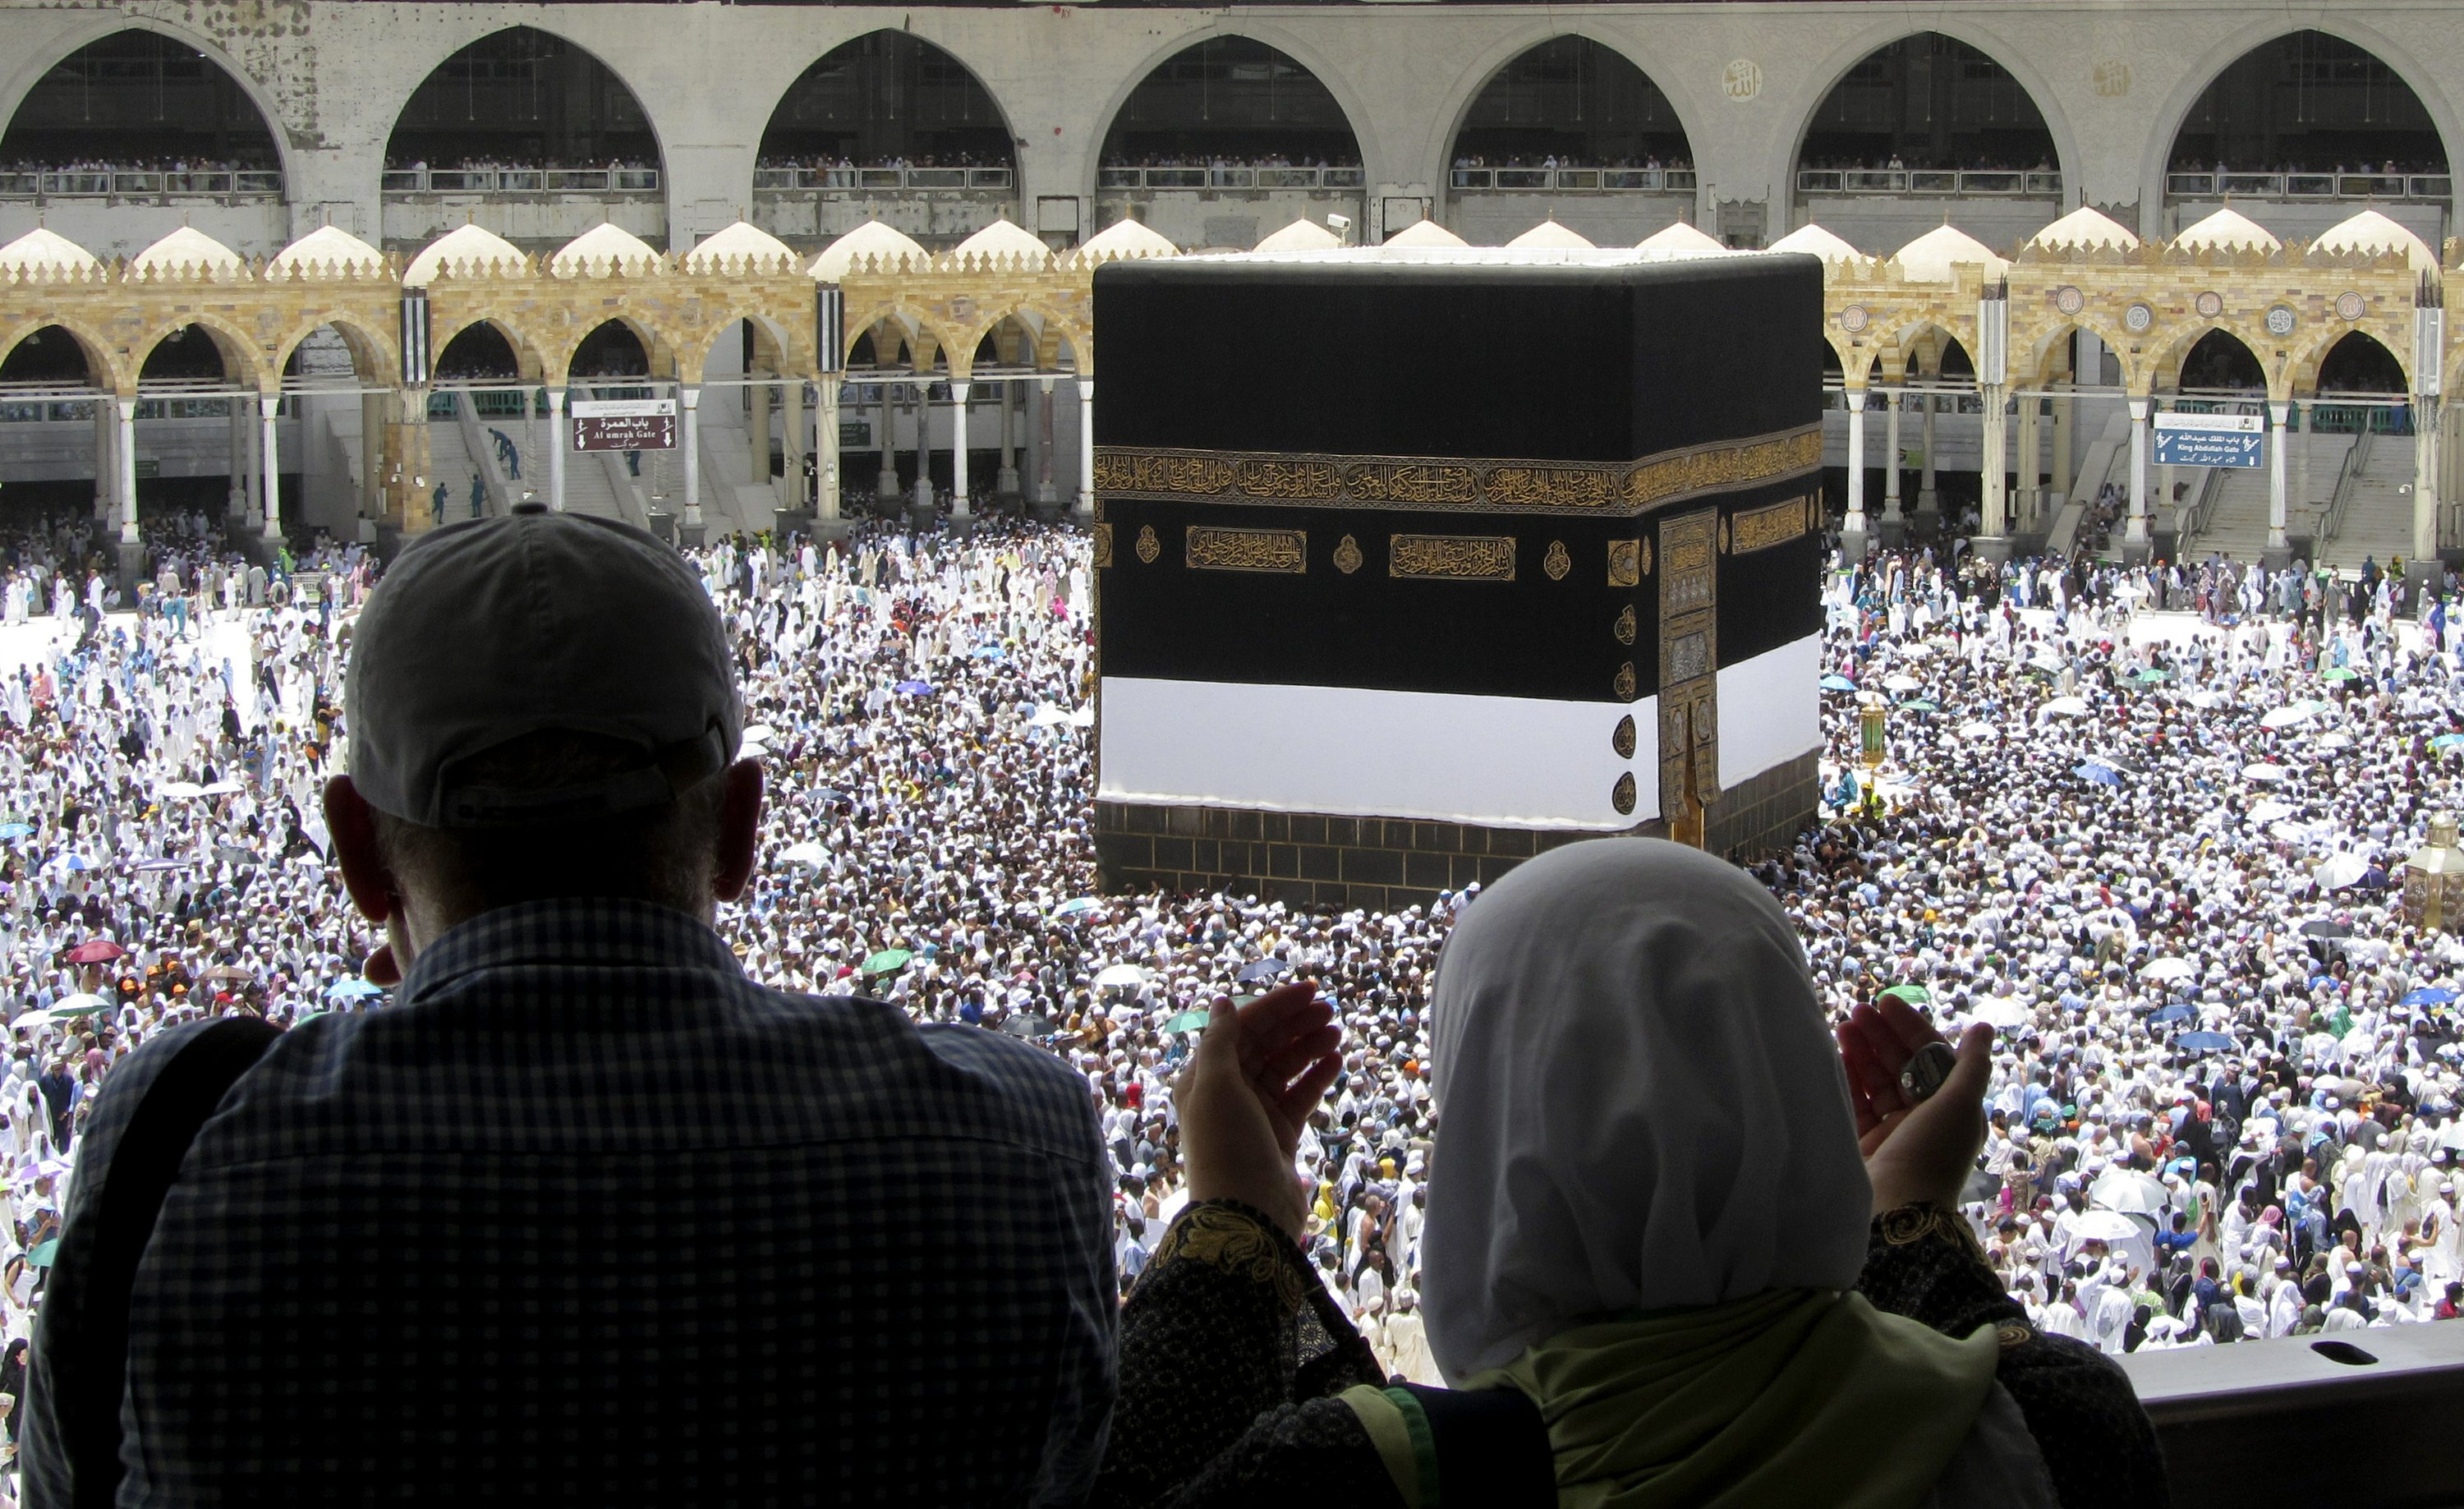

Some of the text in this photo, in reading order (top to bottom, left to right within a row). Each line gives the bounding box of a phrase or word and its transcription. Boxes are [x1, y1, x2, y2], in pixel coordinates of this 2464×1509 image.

[600, 417, 650, 430] باب العمرة
[606, 430, 634, 439] umrah
[2226, 436, 2240, 444] باب
[2177, 444, 2193, 453] King
[2194, 444, 2223, 453] Abdullah
